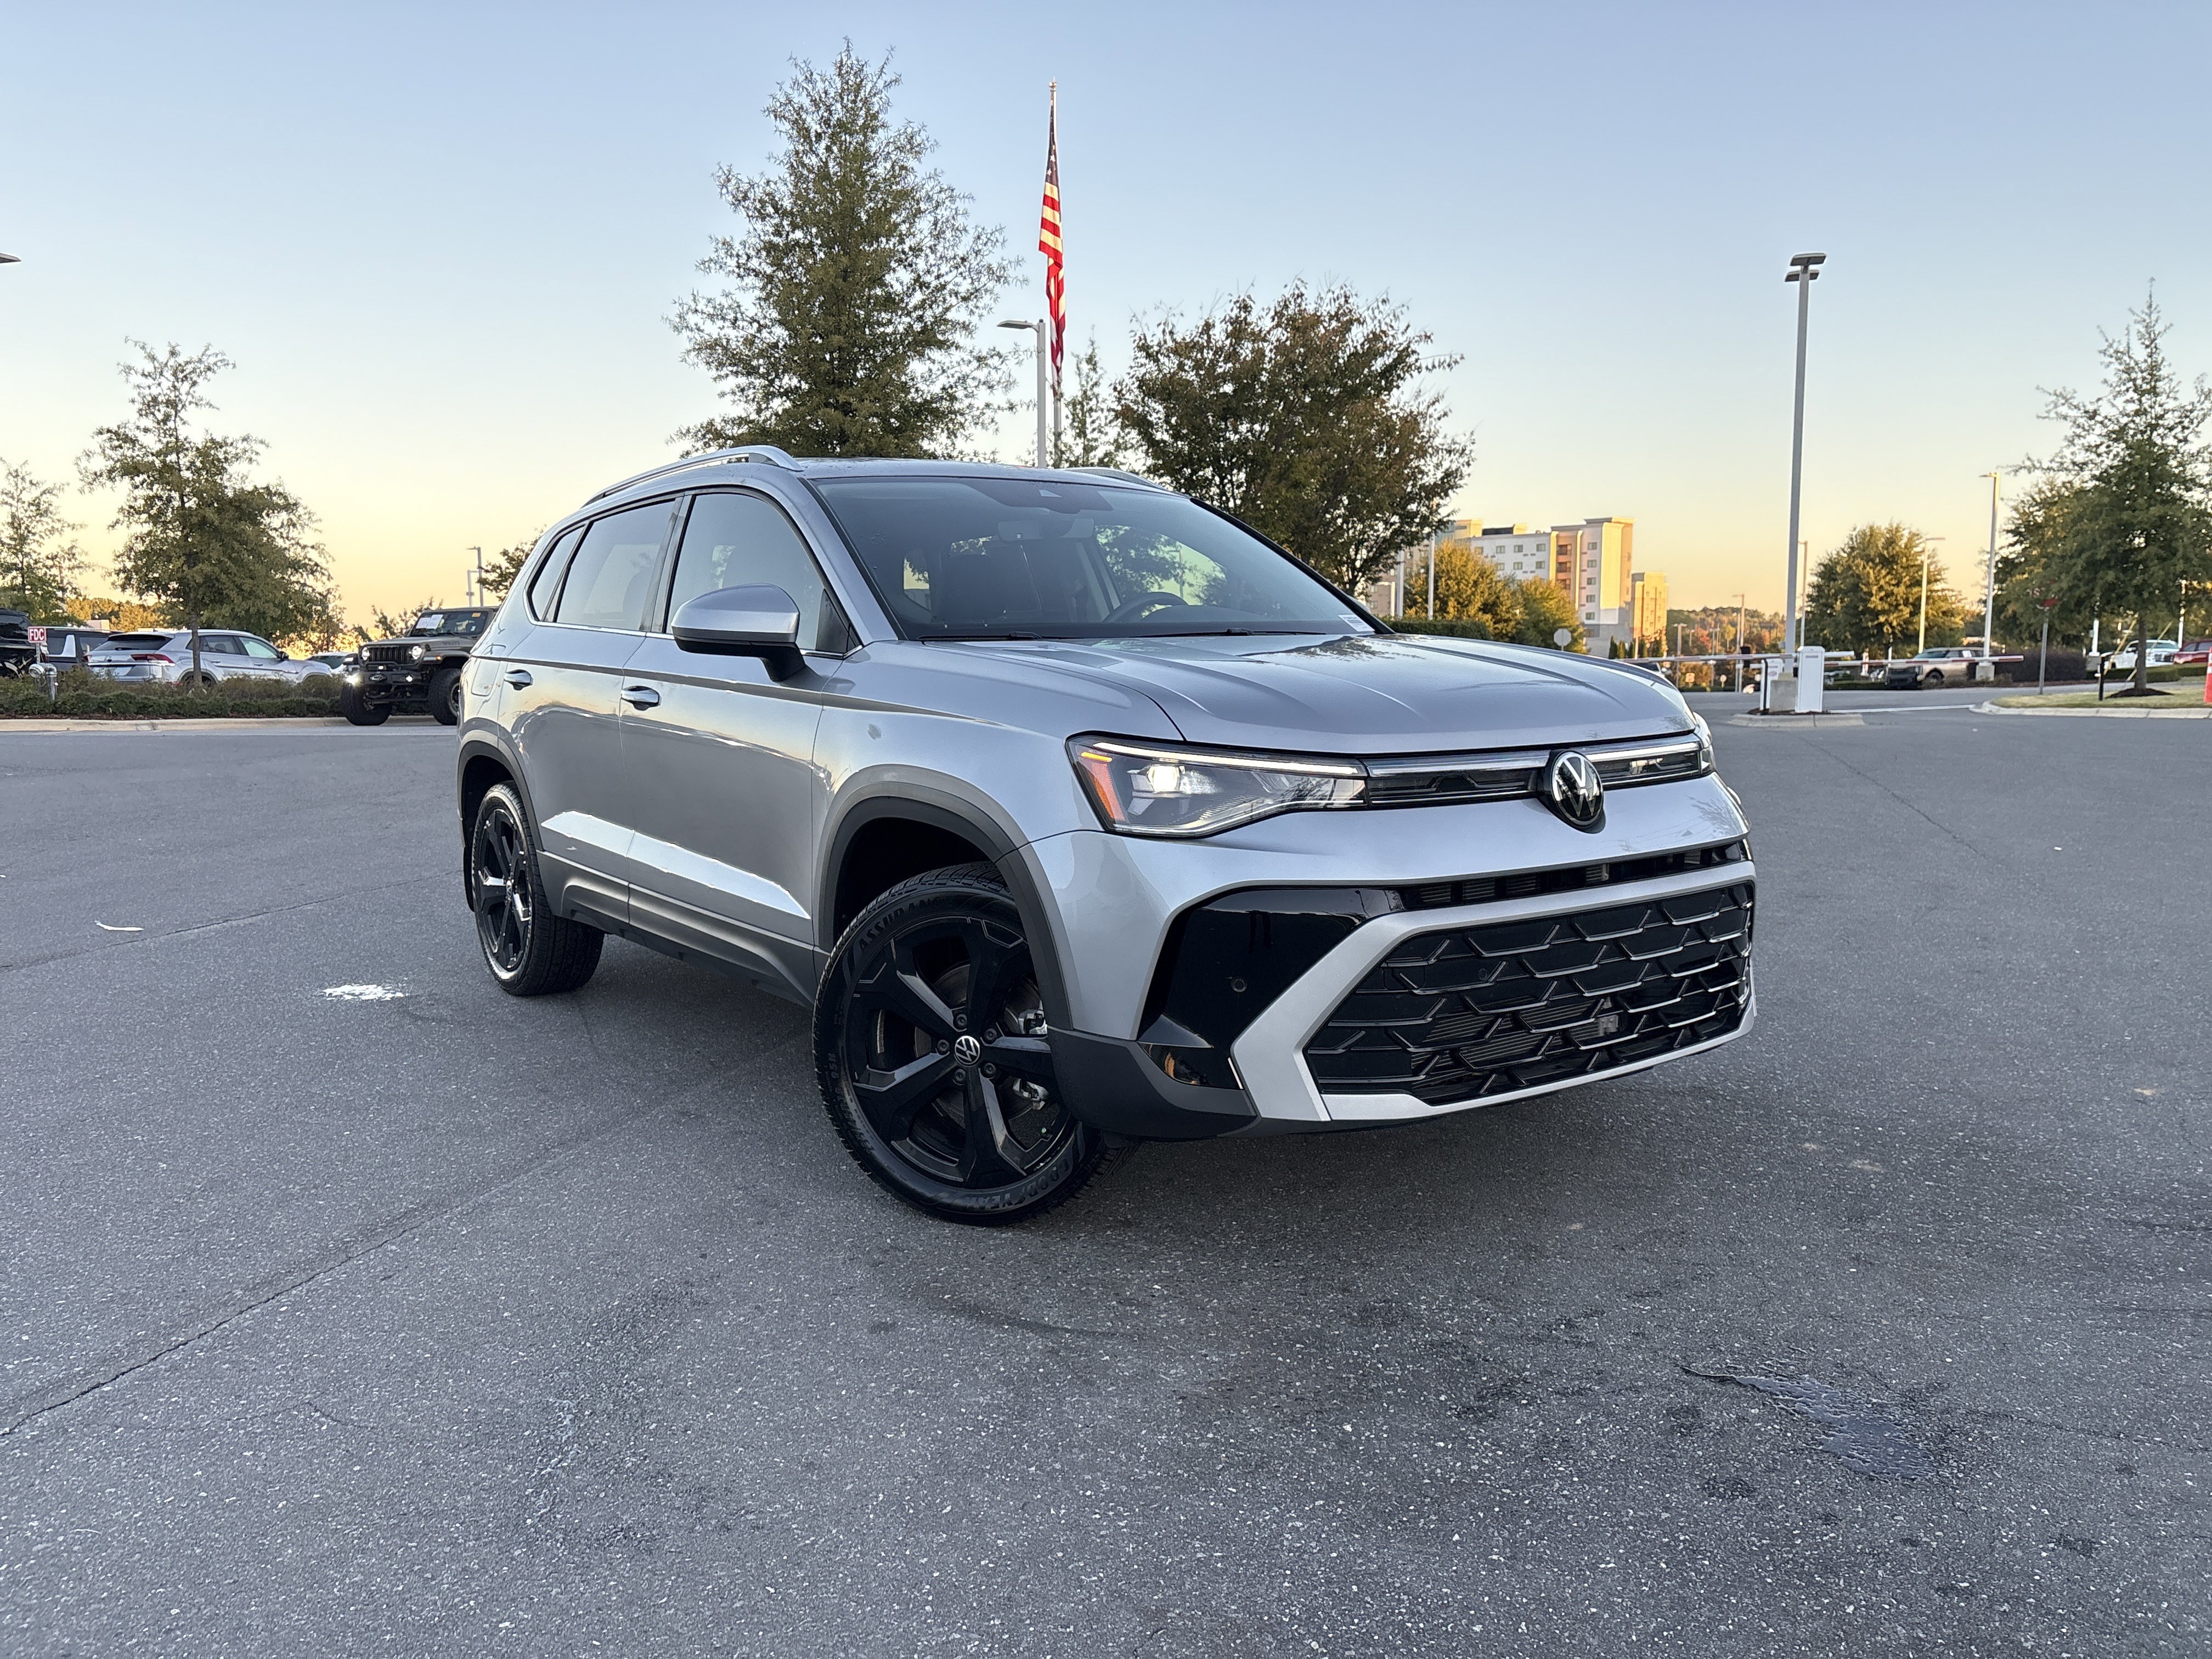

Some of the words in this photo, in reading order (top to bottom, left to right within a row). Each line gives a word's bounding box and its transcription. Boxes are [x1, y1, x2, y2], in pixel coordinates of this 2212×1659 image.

[29, 628, 44, 641] FDC
[1553, 752, 1602, 825] VW
[955, 1036, 980, 1064] VW
